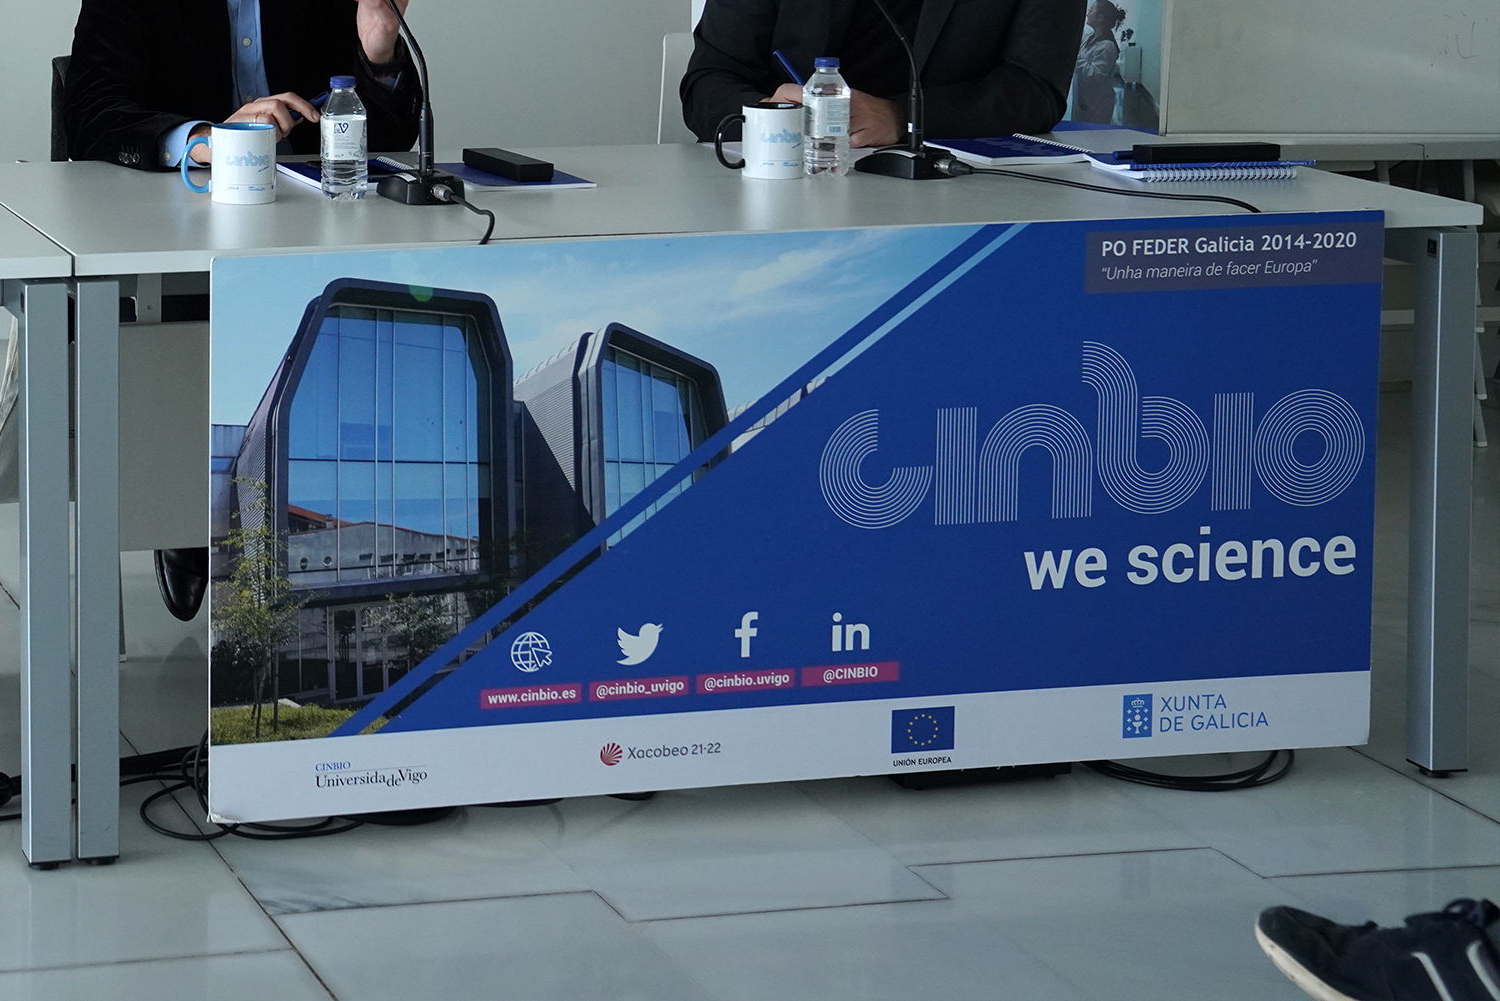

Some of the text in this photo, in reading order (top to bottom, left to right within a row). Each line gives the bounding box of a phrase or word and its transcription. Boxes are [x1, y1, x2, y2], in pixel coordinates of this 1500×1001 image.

[1102, 232, 1357, 257] PO FEDER Galicia 2014-2020
[1146, 263, 1201, 278] maneira
[1206, 262, 1222, 275] de
[1226, 261, 1261, 276] facer
[819, 341, 1366, 529] cinbio
[1023, 525, 1357, 590] we science
[832, 612, 870, 652] in
[704, 673, 790, 691] @cinbio.uvigo
[823, 666, 879, 682] @CINBIO
[488, 687, 577, 705] www.cinbio.es
[596, 680, 685, 699] @cinbio_uvigo
[1160, 694, 1227, 713] XUNTA
[1160, 711, 1269, 733] DE GALICIA
[627, 745, 689, 759] Xacobeo
[315, 761, 351, 772] CINBIO
[893, 756, 952, 767] UNIÓN EUROPEA
